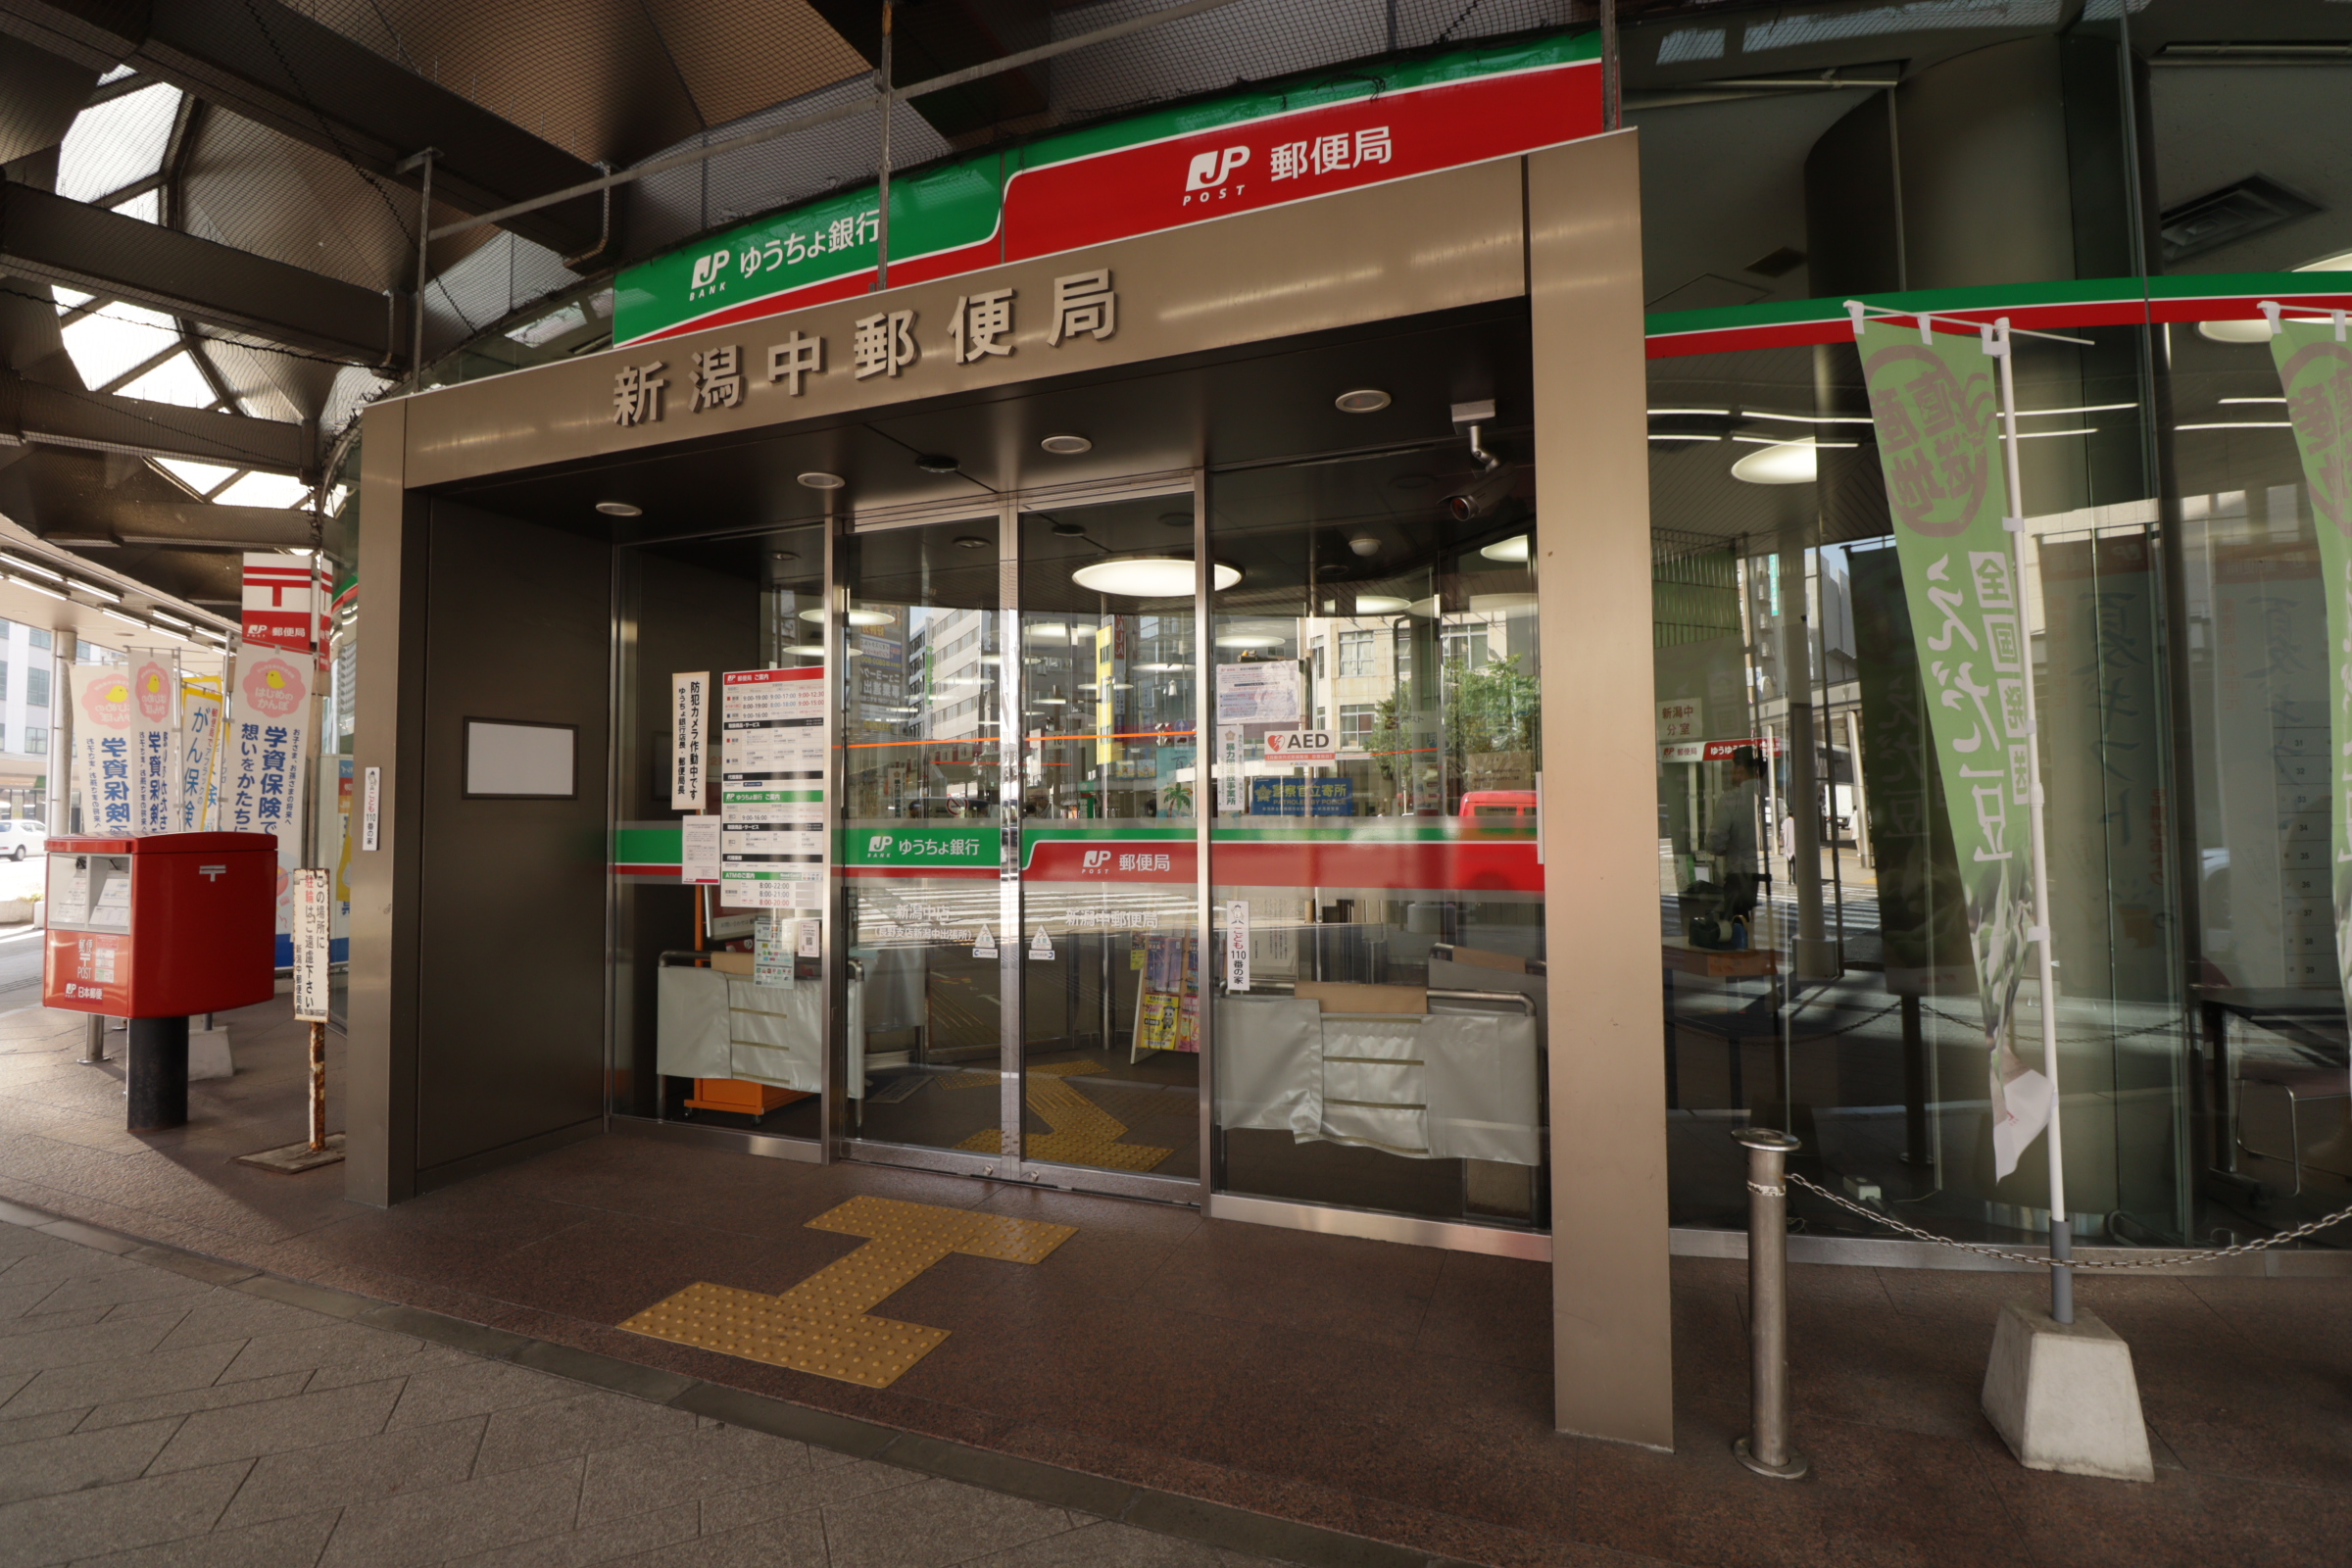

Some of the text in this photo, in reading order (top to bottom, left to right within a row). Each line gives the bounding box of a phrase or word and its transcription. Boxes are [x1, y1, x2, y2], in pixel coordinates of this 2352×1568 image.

[1270, 125, 1393, 182] 郵便局
[1183, 184, 1245, 206] POST
[740, 209, 880, 278] ゆうちょ銀行
[689, 281, 726, 302] BANK
[612, 268, 1117, 427] 新潟中郵便局
[272, 627, 306, 637] 郵便局
[255, 687, 293, 701] はじめの
[257, 698, 289, 711] かんぽ
[1662, 705, 1693, 719] 新潟中
[1667, 722, 1690, 736] 分室
[689, 681, 701, 802] 防犯カメラ作動中です
[1287, 734, 1329, 749] AED
[1677, 748, 1697, 757] 郵便局
[258, 725, 287, 835] 学資保険で
[899, 839, 980, 856] ゆうちょ銀行
[1119, 854, 1170, 871] 郵便局
[896, 904, 951, 920] 新潟中店
[1065, 908, 1158, 928] 新潟中郵便局
[1230, 926, 1247, 985] こども110番の家
[77, 966, 92, 980] POST
[78, 987, 103, 1001] 日本郵便
